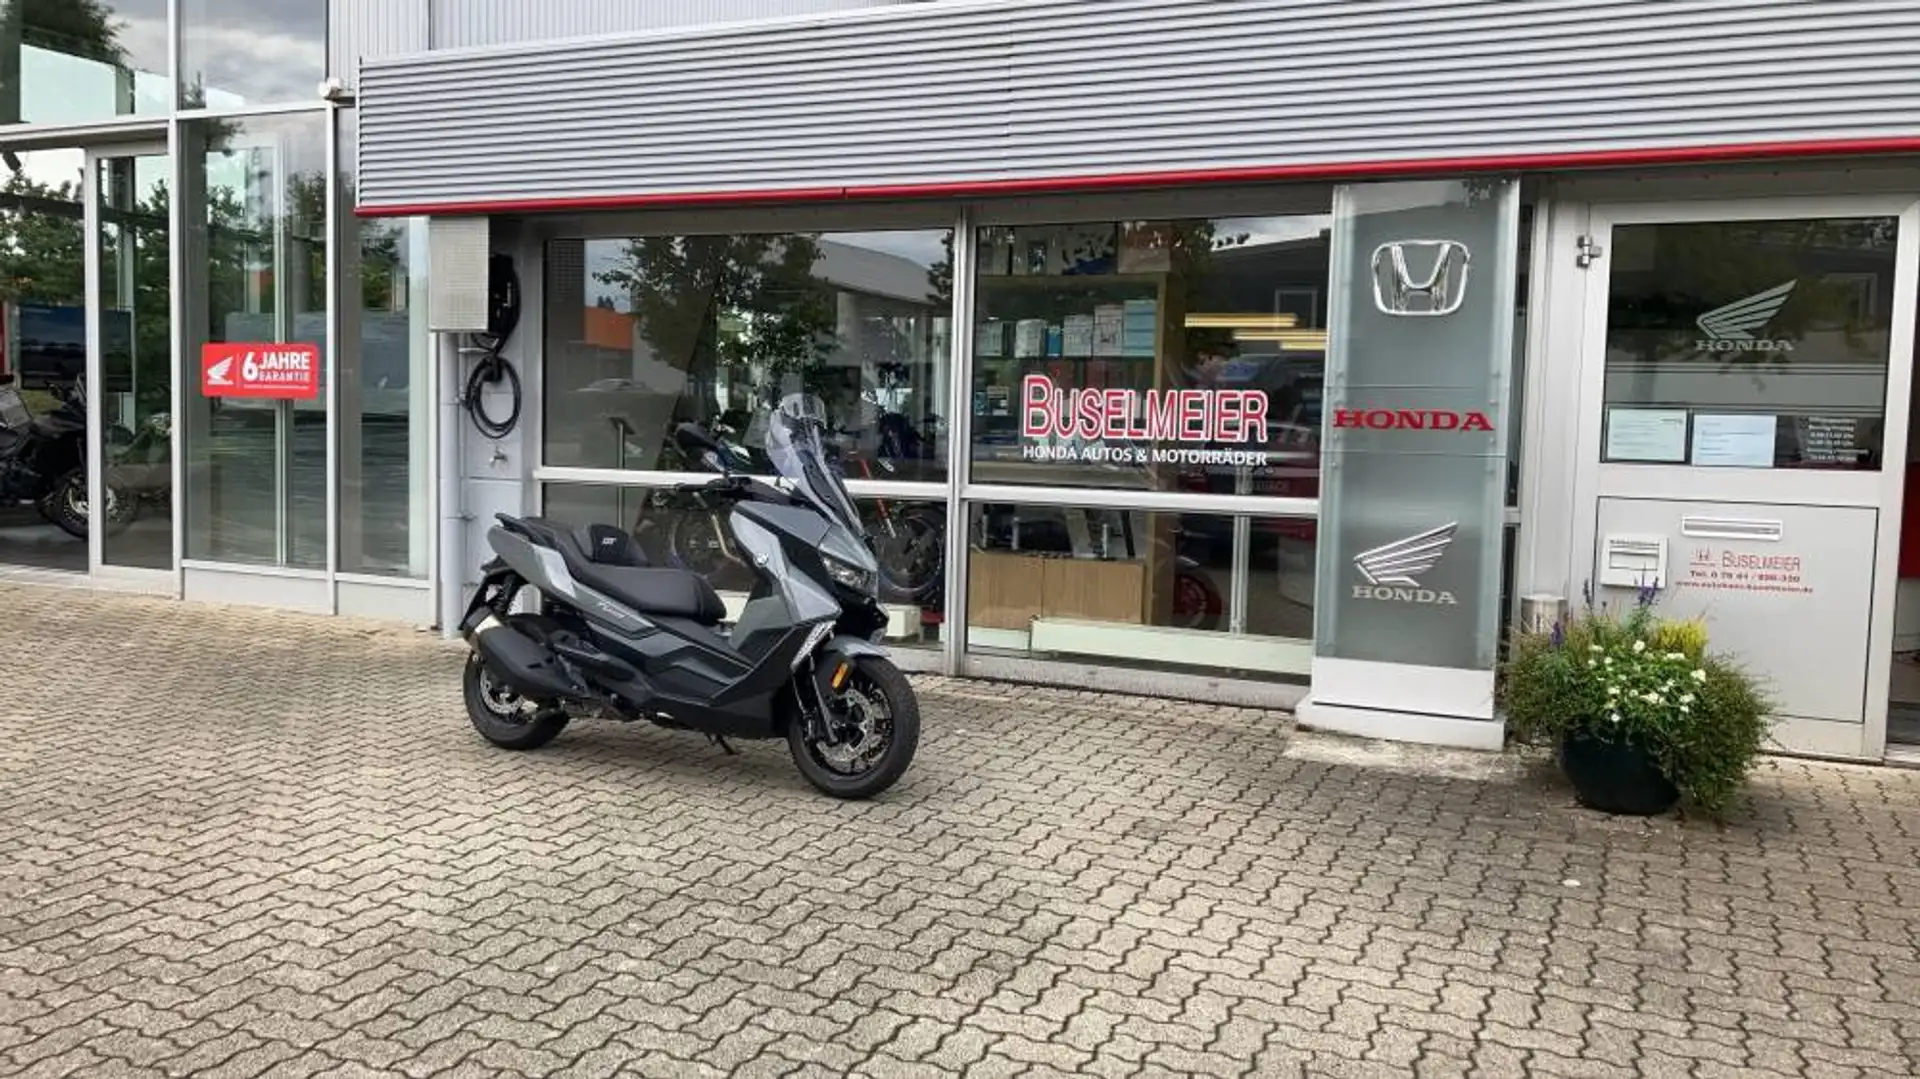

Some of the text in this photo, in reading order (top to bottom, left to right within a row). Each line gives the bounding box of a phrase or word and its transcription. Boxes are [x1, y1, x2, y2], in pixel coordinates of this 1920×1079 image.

[1696, 339, 1794, 351] HONDA
[242, 351, 311, 381] 6 JAHRE
[259, 371, 310, 382] GARANTIE
[1023, 374, 1269, 442] BUSELMEIER
[1333, 408, 1495, 431] HONDA
[1023, 445, 1267, 466] HONDA AUTOS & MOTORRÄDER
[1352, 585, 1457, 604] HONDA
